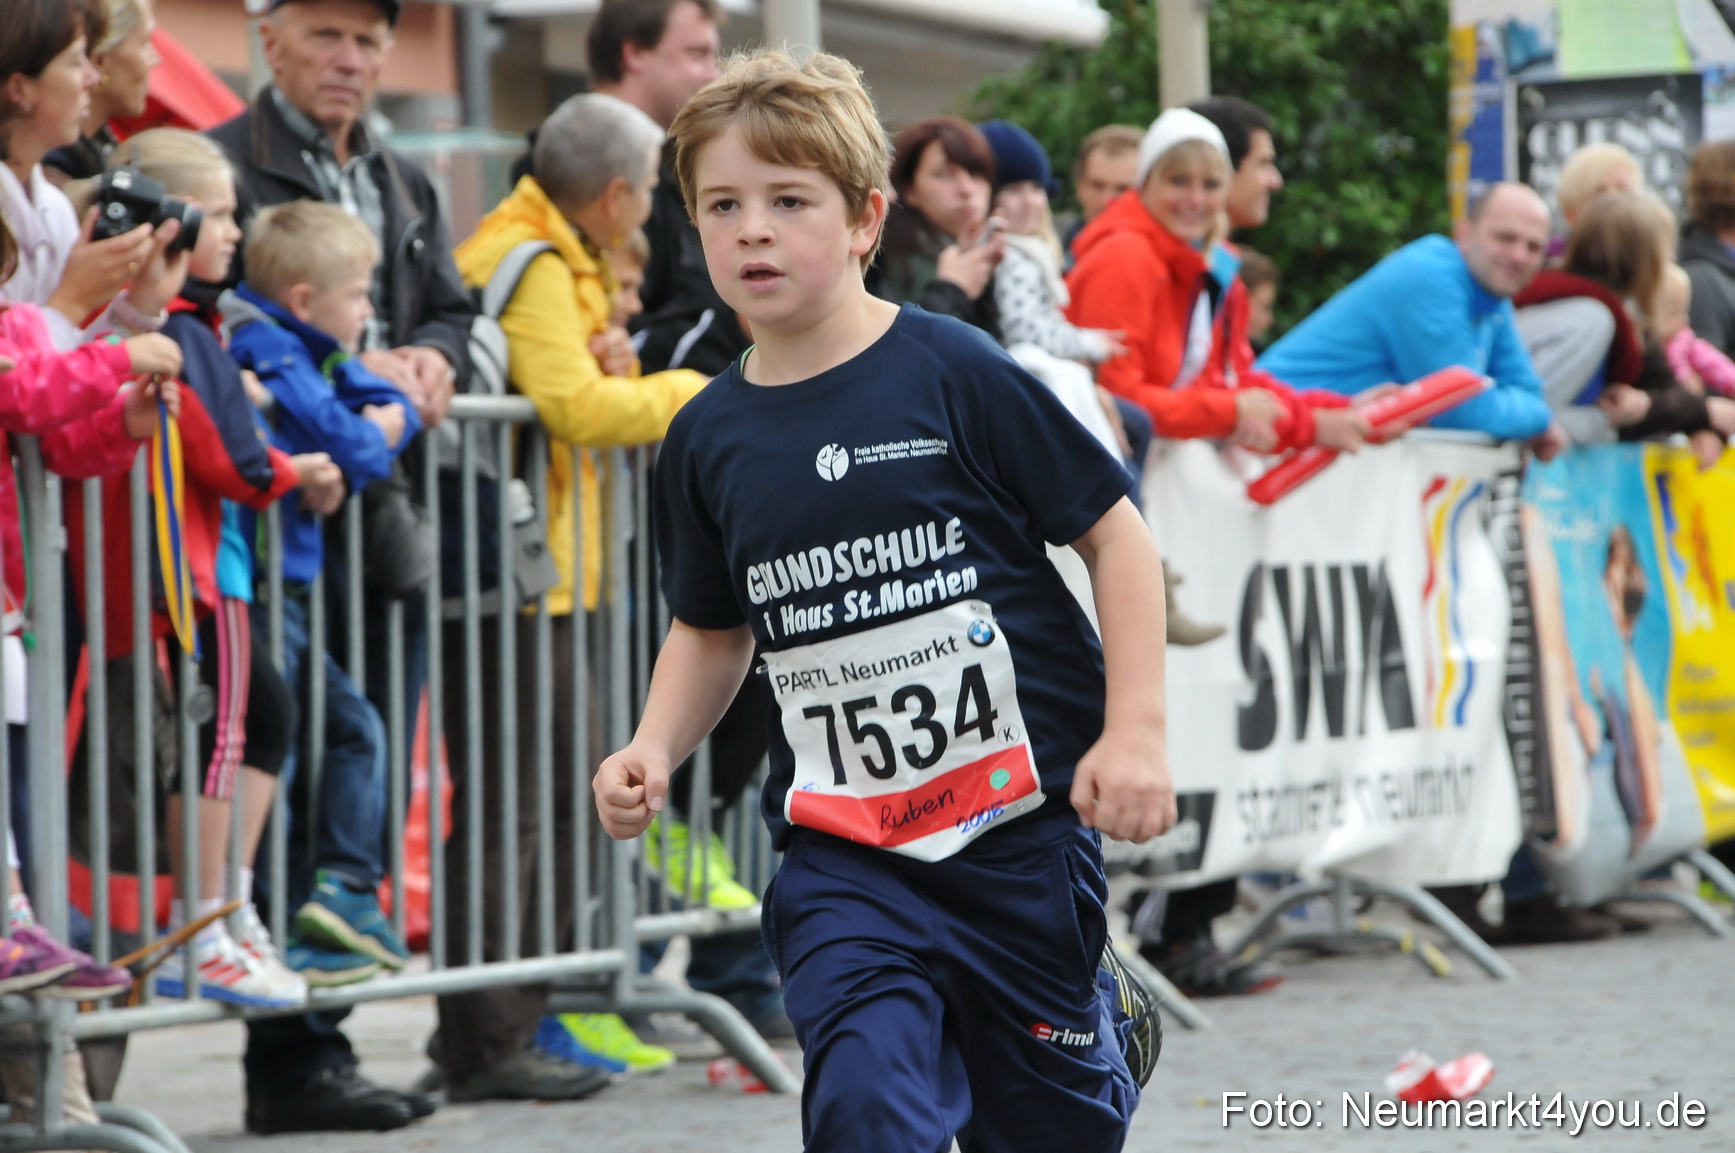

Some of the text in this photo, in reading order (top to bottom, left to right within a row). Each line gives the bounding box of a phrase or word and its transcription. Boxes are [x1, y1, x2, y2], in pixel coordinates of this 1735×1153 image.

[854, 438, 948, 456] Freie katholische Volksschule
[863, 454, 878, 463] Haus
[780, 603, 834, 637] Haus
[843, 566, 978, 623] St.Marien
[775, 635, 960, 694] PARTL Neumarkt
[802, 663, 998, 787] 7534
[1003, 726, 1014, 742] K
[880, 788, 954, 830] Ruben
